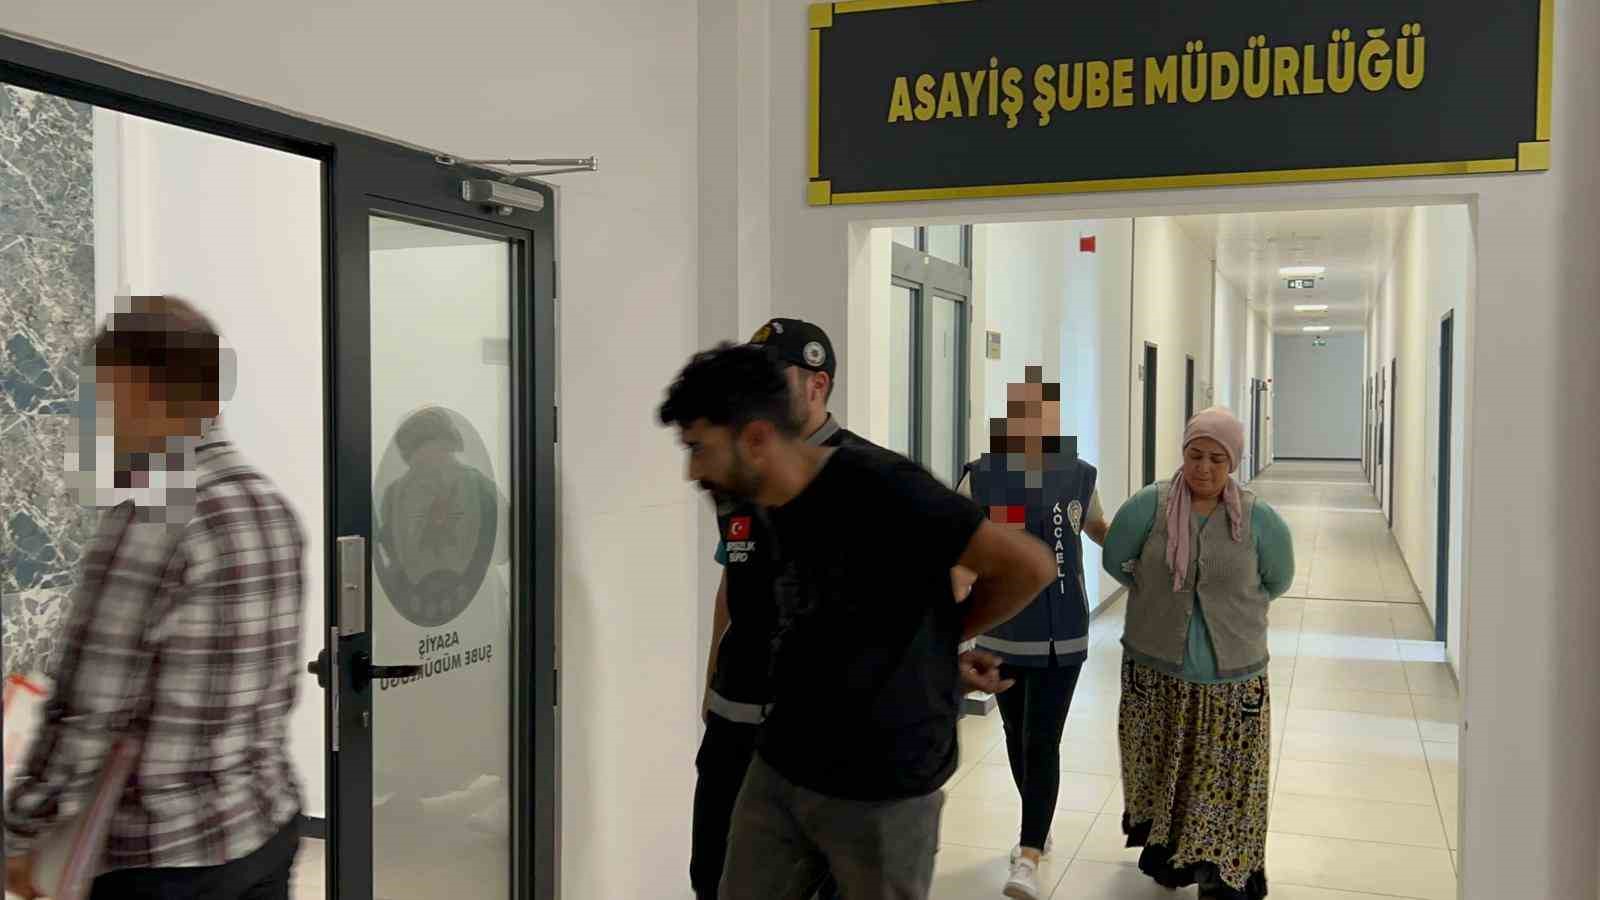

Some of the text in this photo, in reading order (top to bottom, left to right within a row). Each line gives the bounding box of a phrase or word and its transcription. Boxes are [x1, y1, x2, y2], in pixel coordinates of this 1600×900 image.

[887, 22, 1425, 129] ASAYİŞ ŞUBE MÜDÜRLÜĞÜ
